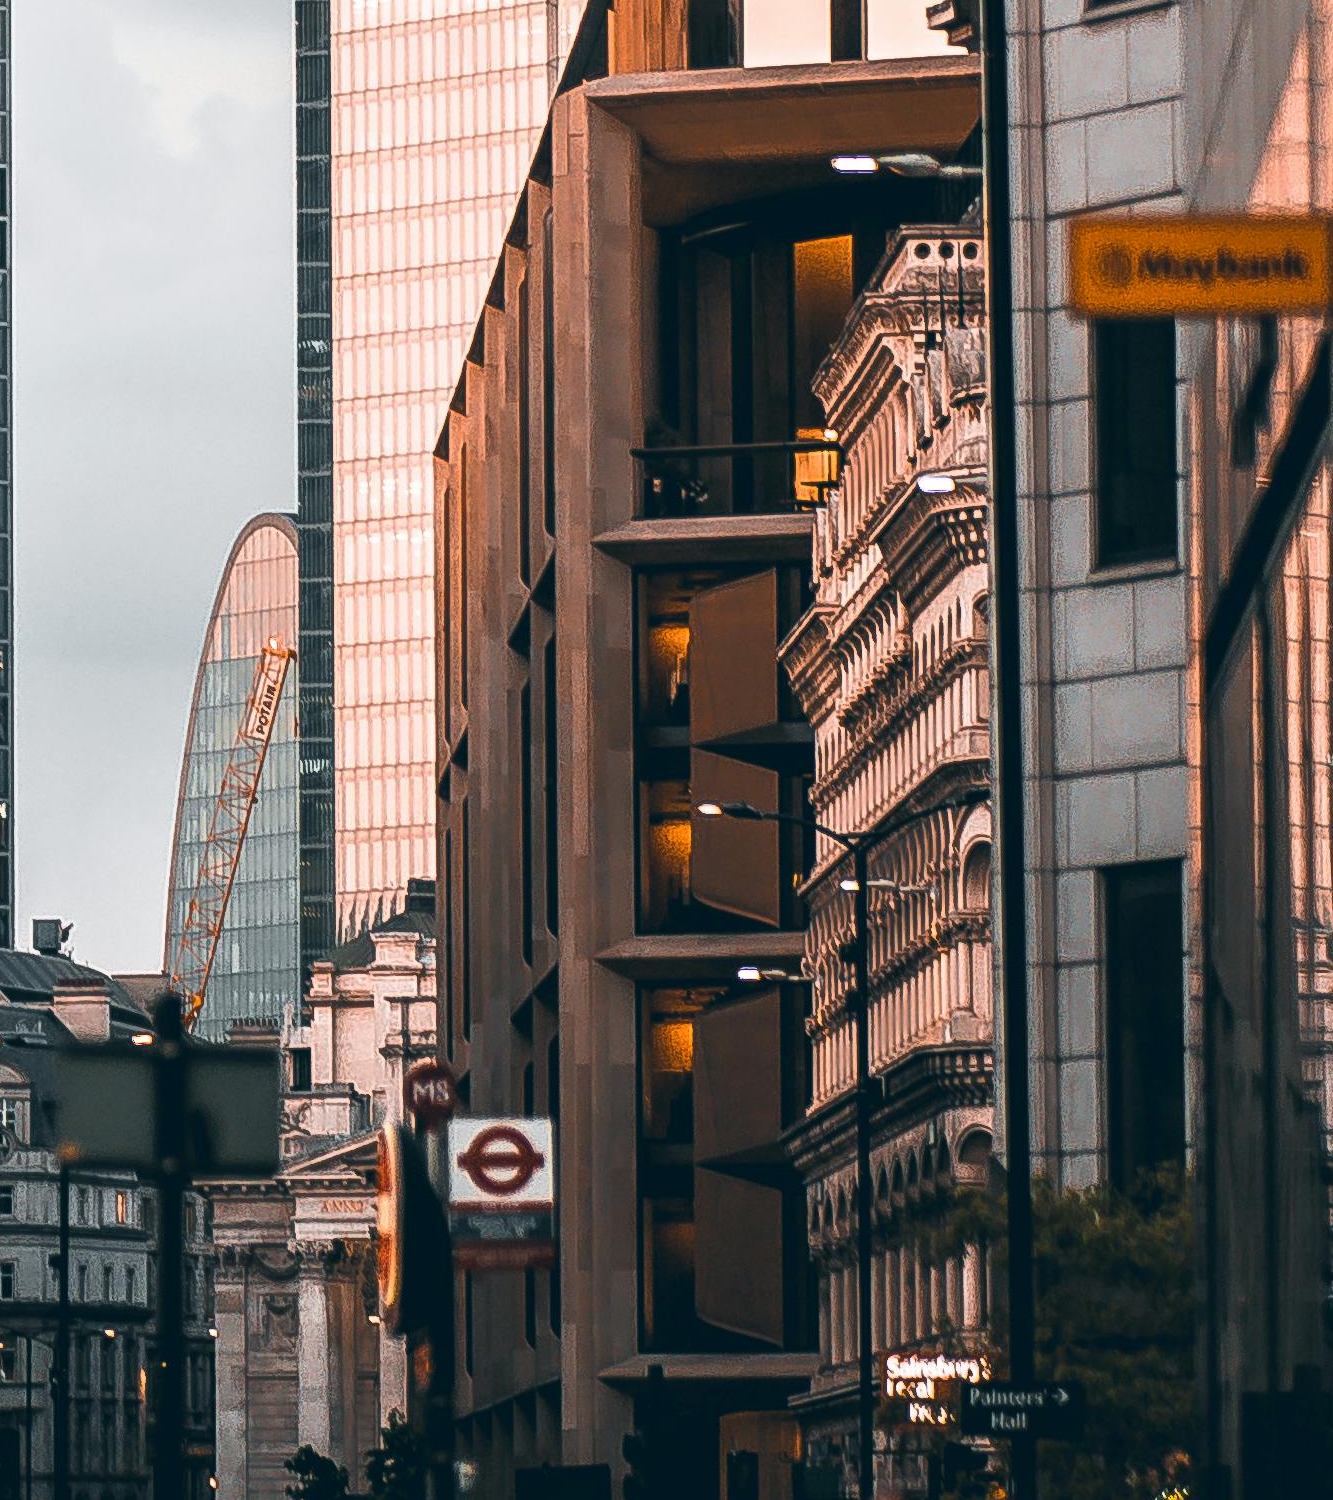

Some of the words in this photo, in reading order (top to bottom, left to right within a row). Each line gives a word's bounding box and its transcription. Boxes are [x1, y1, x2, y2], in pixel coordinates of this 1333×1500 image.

[1136, 247, 1309, 288] Maybank
[256, 684, 277, 735] POTAIN
[969, 1387, 1047, 1406] Painters'
[991, 1411, 1027, 1430] Hall
